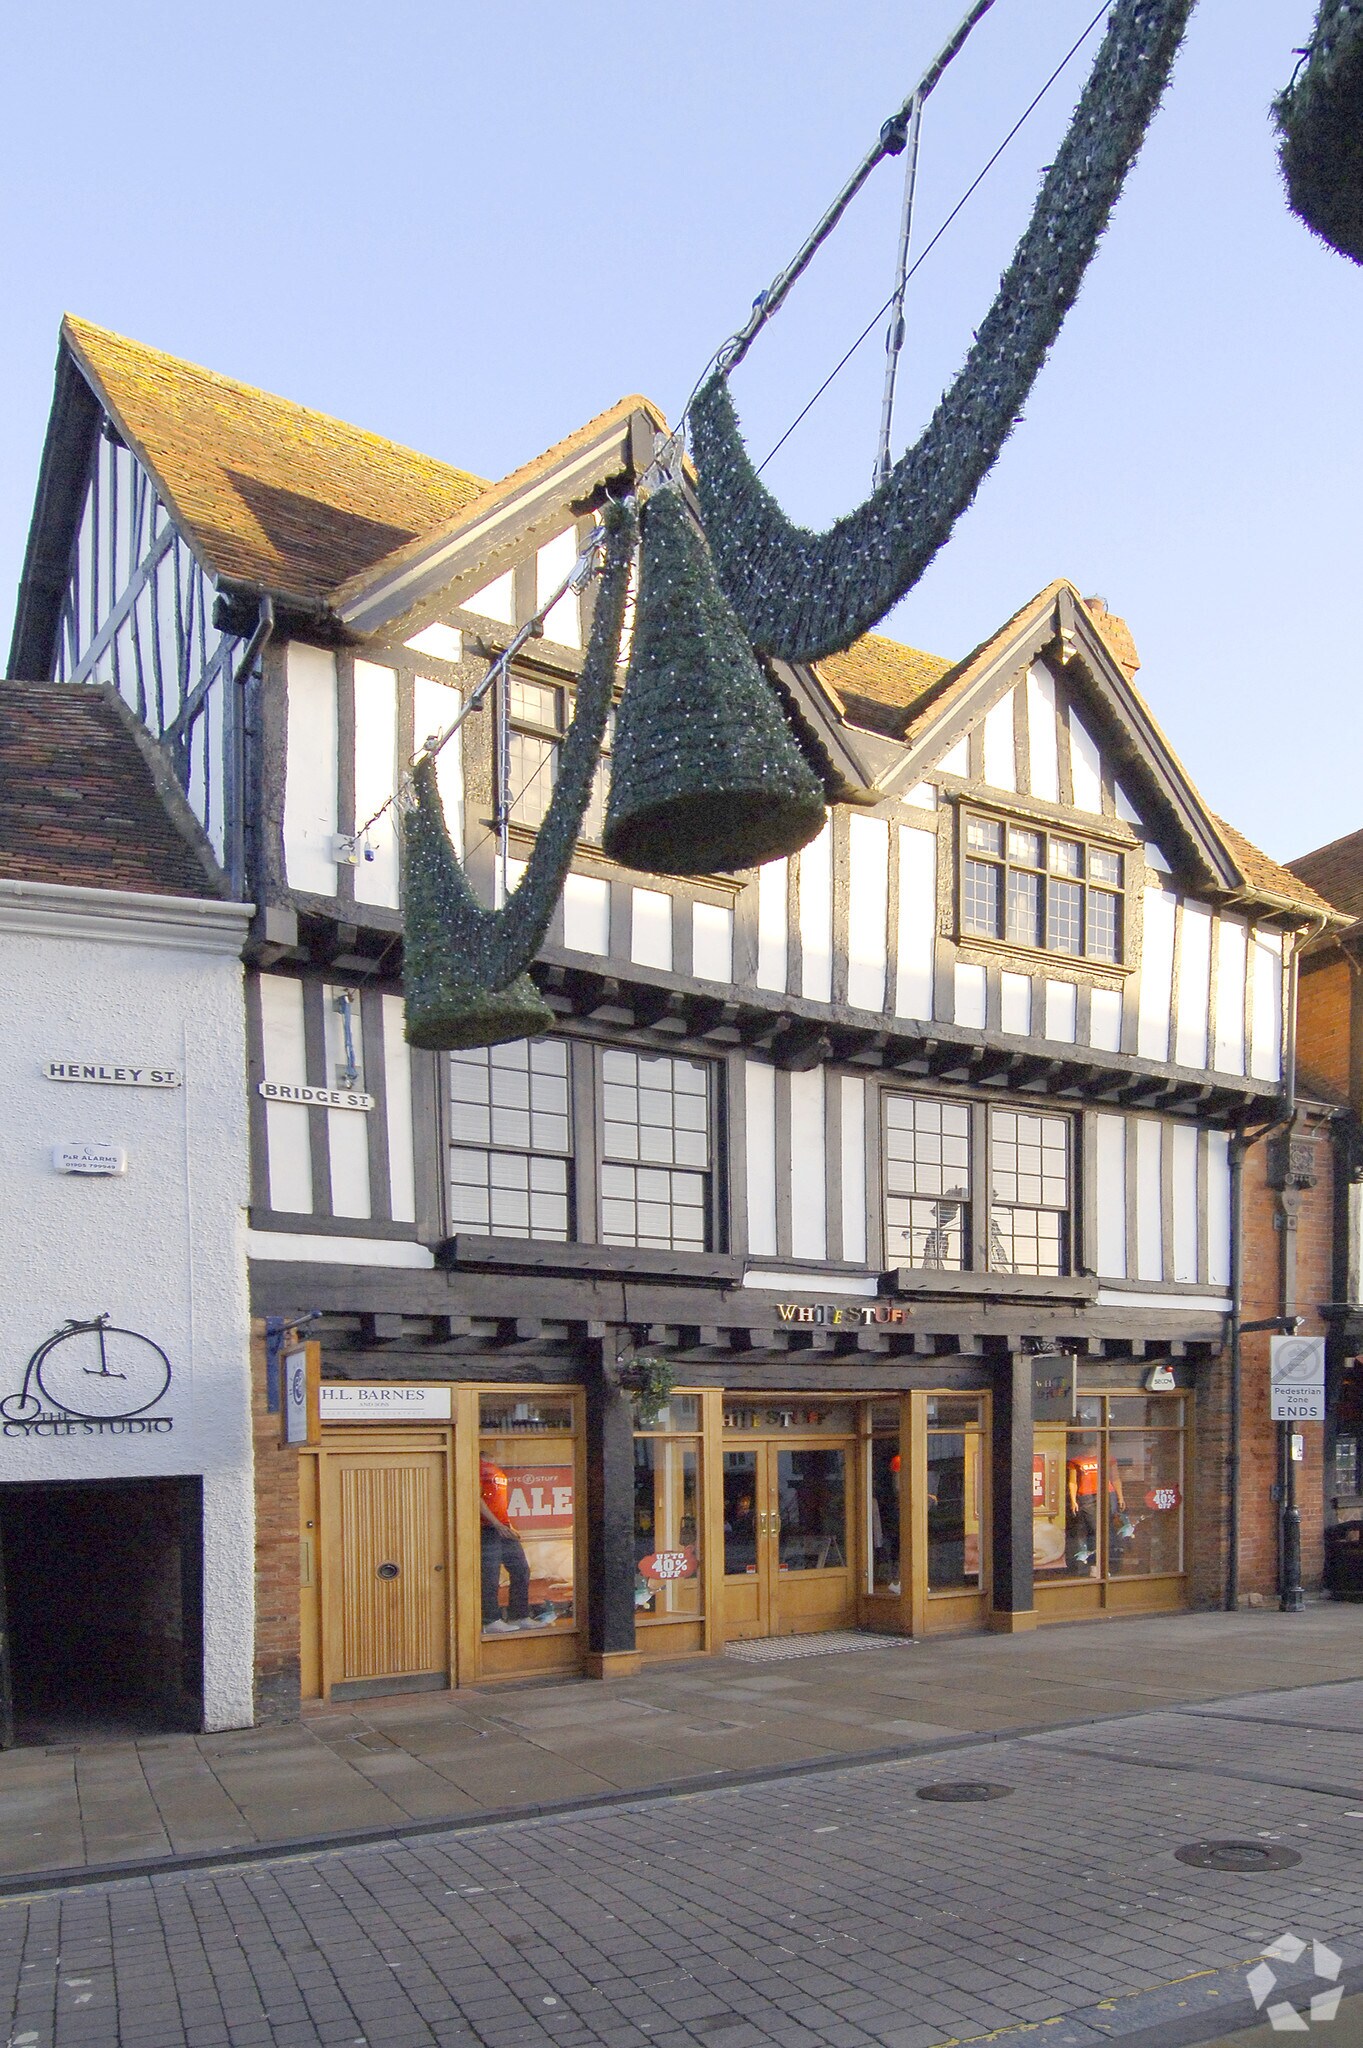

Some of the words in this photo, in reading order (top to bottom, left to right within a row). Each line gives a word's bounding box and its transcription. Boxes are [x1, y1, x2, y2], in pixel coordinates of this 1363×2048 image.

[50, 1064, 143, 1082] HENLEY
[150, 1071, 175, 1083] ST
[265, 1084, 340, 1104] BRIDGE
[348, 1095, 368, 1106] ST
[776, 1303, 843, 1326] WHITE
[846, 1306, 908, 1325] STUFF
[322, 1390, 352, 1400] H.L.
[358, 1390, 425, 1400] BARNES
[40, 1412, 72, 1422] THE
[1278, 1407, 1317, 1416] ENDS
[4, 1422, 77, 1437] CYCLE
[83, 1420, 173, 1435] STUDIO
[508, 1487, 572, 1516] ALE
[1153, 1494, 1175, 1504] 40%
[652, 1559, 688, 1572] 40%
[660, 1570, 681, 1578] OFF
